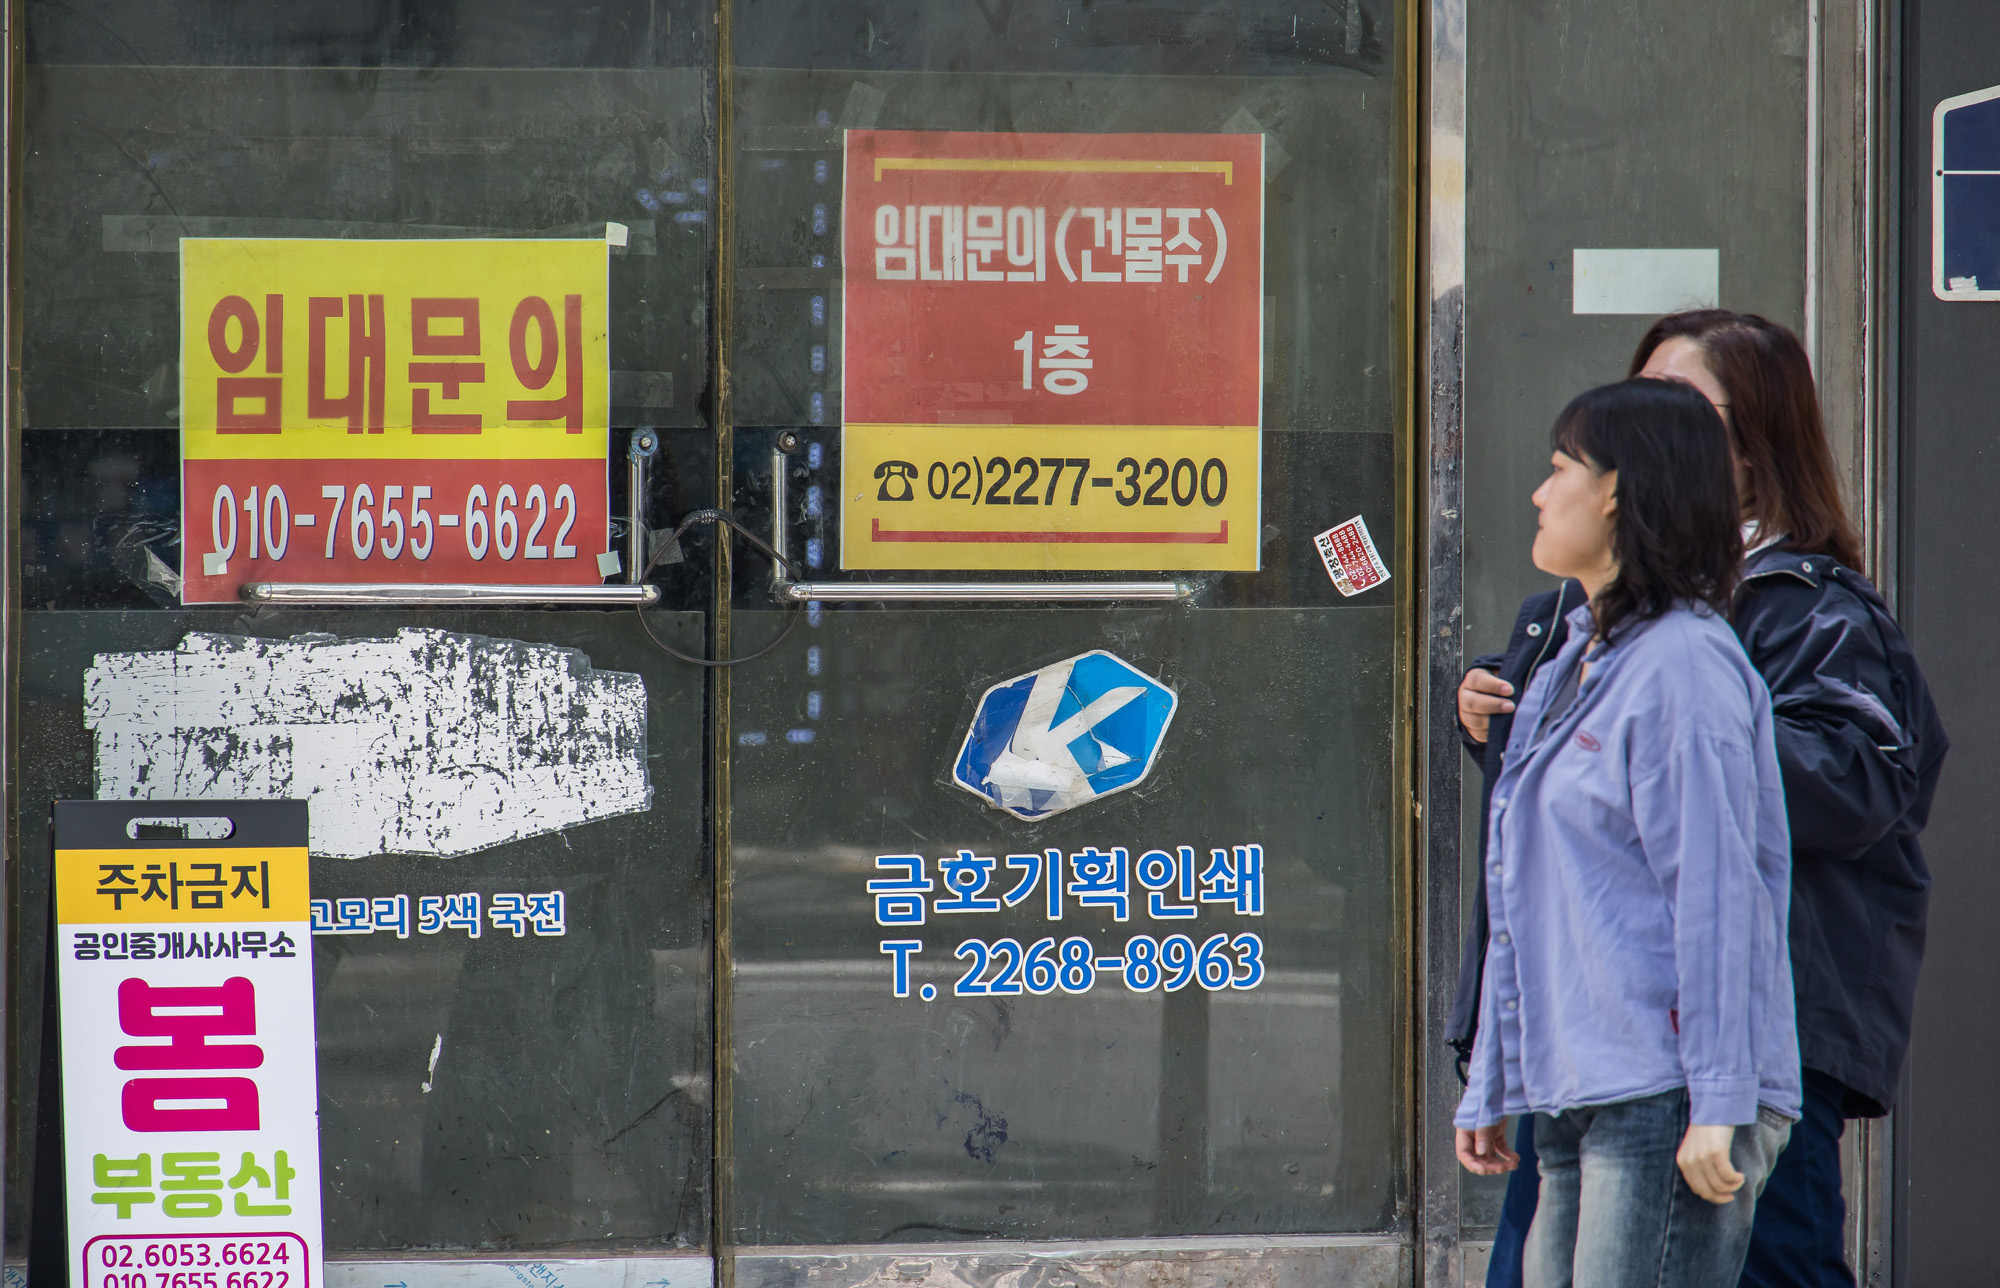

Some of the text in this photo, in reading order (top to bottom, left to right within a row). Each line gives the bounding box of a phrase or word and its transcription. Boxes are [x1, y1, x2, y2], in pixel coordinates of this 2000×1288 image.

[874, 205, 1228, 284] 임대문의(건물주)
[207, 293, 584, 435] 임대문의
[1013, 325, 1093, 396] 1층
[926, 455, 1229, 508] 02)2277-3200
[211, 483, 579, 562] 010-7655-6622
[96, 861, 270, 910] 주차금지
[418, 893, 481, 938] 5색
[488, 891, 566, 938] 국전
[867, 844, 1265, 926] 금호기획인쇄
[73, 930, 297, 960] 공인중개사사무소
[880, 933, 1265, 1002] T. 2268-8963
[113, 976, 264, 1133] 봄
[91, 1150, 296, 1219] 부동산
[101, 1242, 290, 1269] 02.6053.6624
